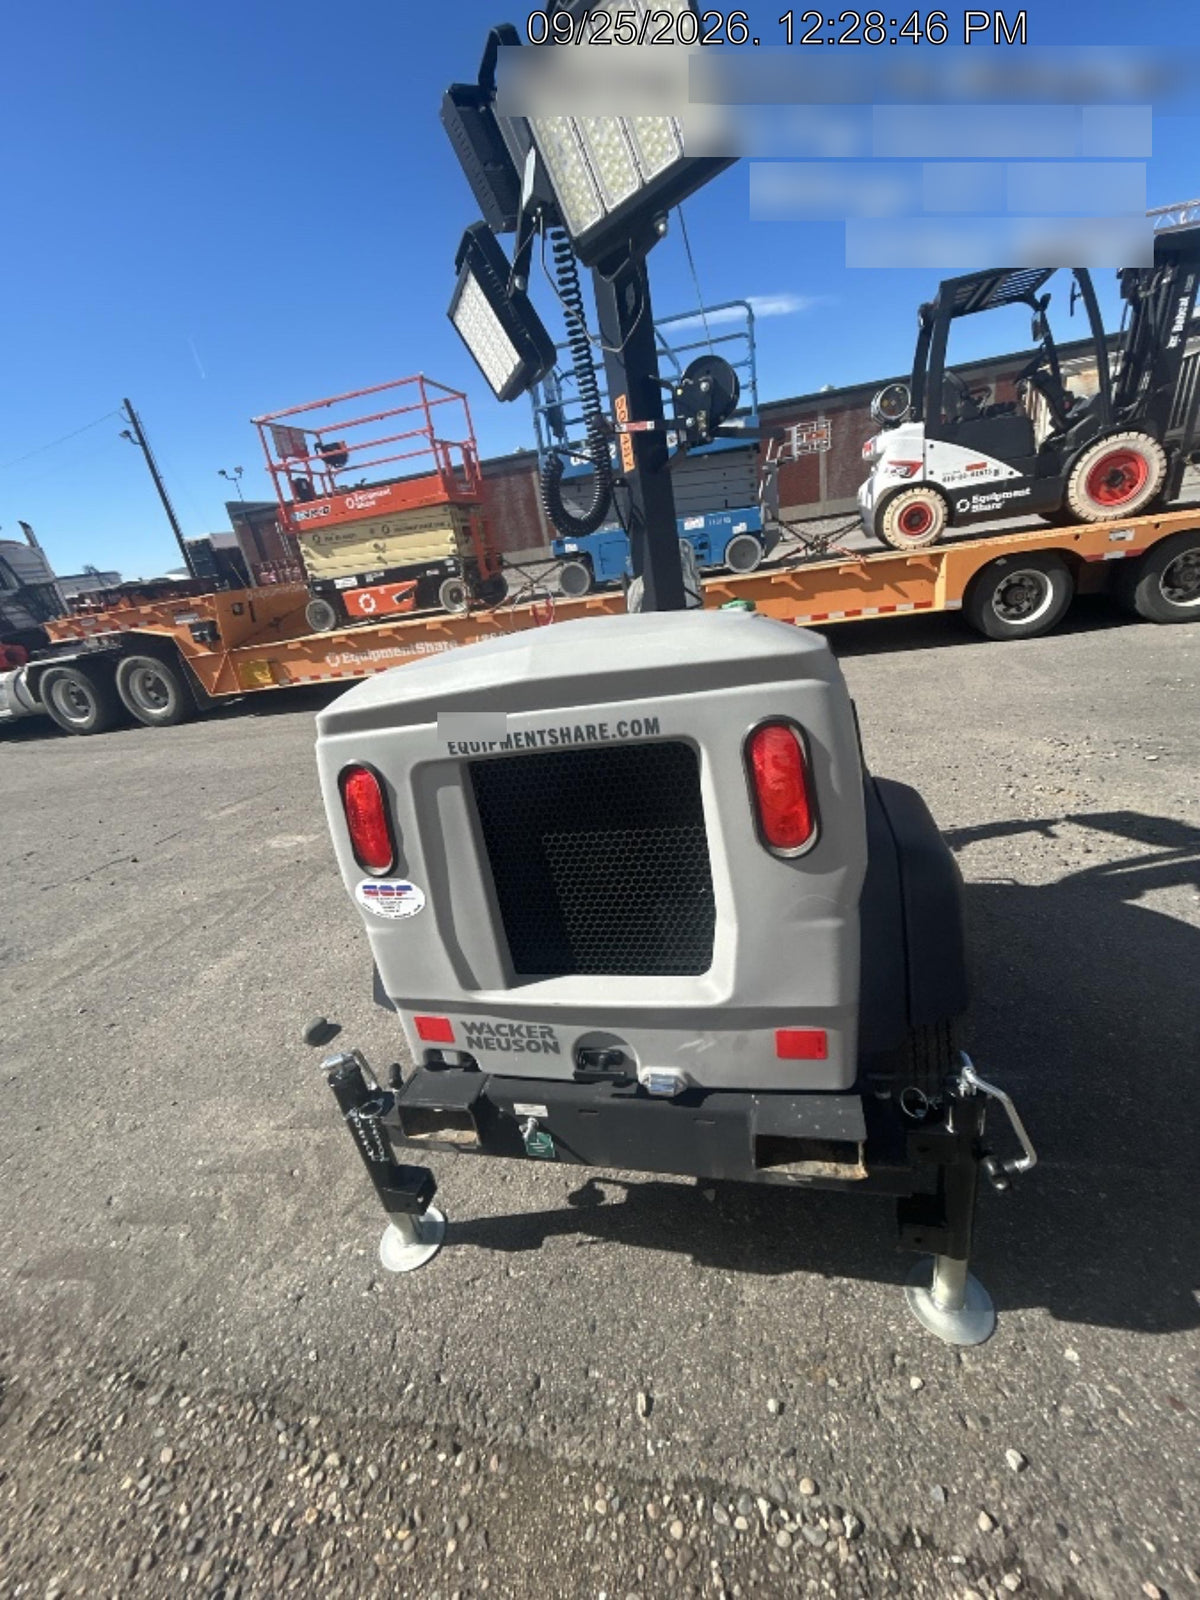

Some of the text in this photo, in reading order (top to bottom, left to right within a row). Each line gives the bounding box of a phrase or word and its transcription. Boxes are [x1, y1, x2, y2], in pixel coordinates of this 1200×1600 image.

[971, 486, 1032, 503] Equipment
[460, 1020, 556, 1040] WACKER
[466, 1035, 561, 1055] NEUSON
